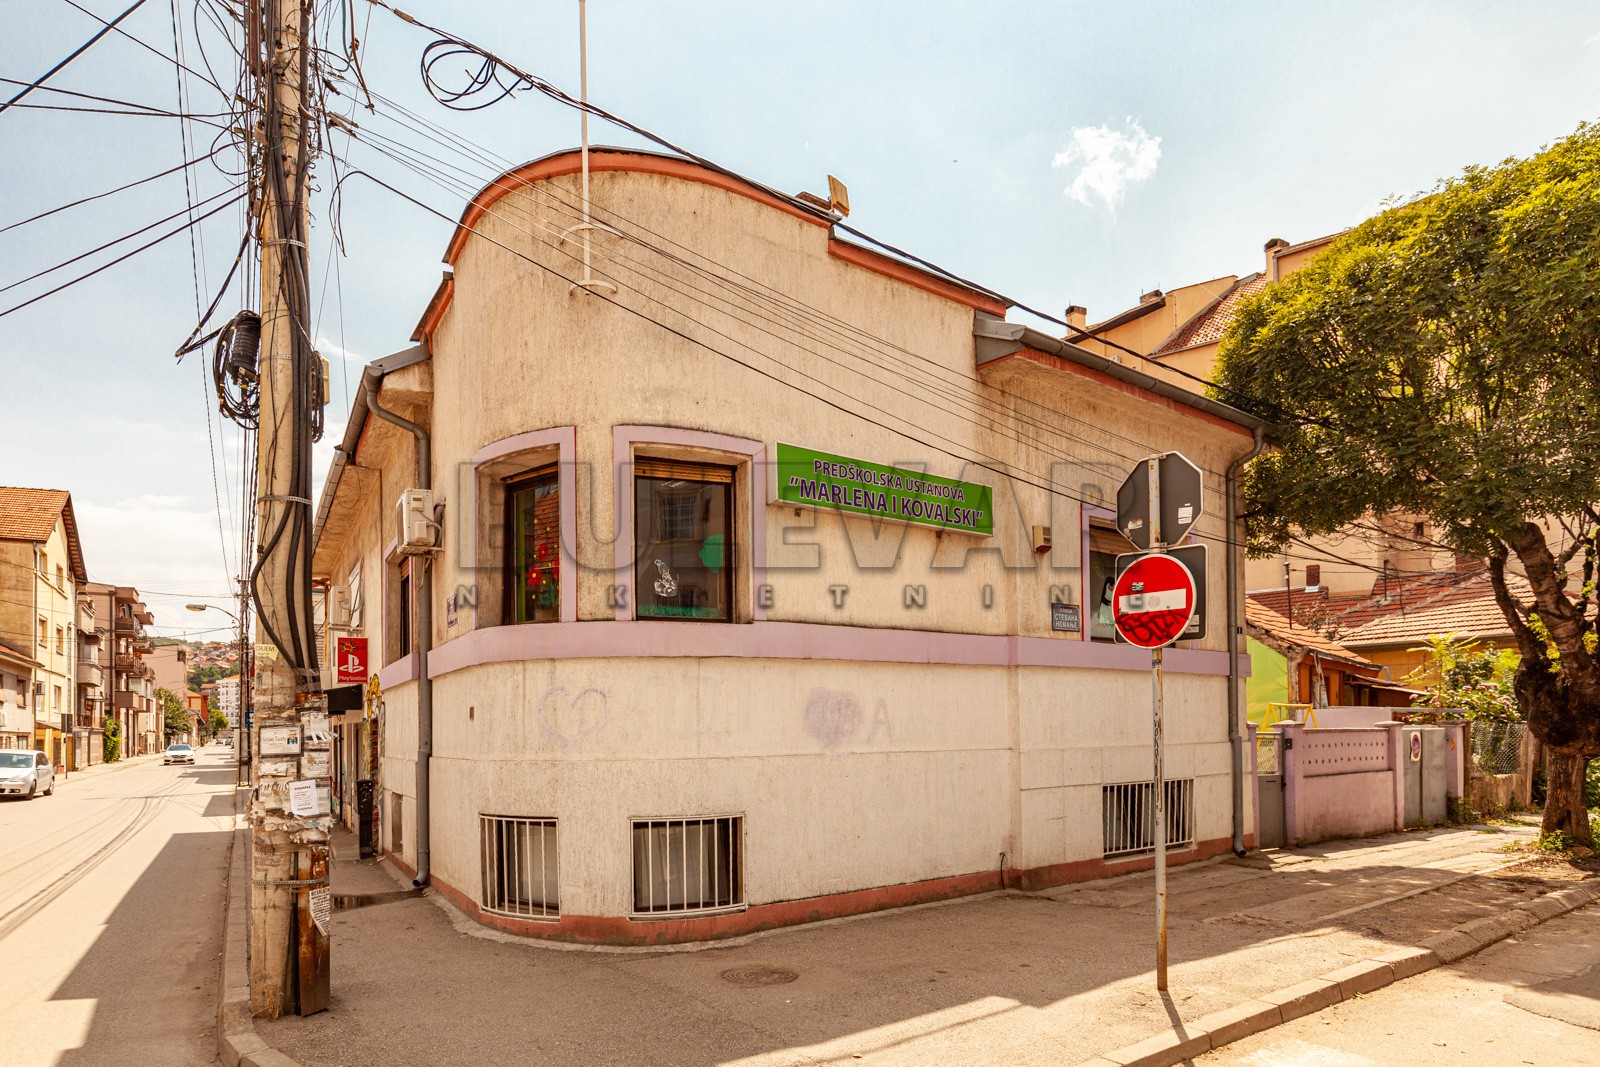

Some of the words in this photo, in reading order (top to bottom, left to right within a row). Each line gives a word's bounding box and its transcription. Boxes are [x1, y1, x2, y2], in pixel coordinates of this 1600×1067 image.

[813, 459, 903, 490] PREDŠKOLSKA
[905, 478, 965, 502] USTANOVA
[892, 495, 897, 514] I
[1055, 613, 1078, 621] СТЕВАНА
[1055, 620, 1078, 628] НЕМАЊЕ
